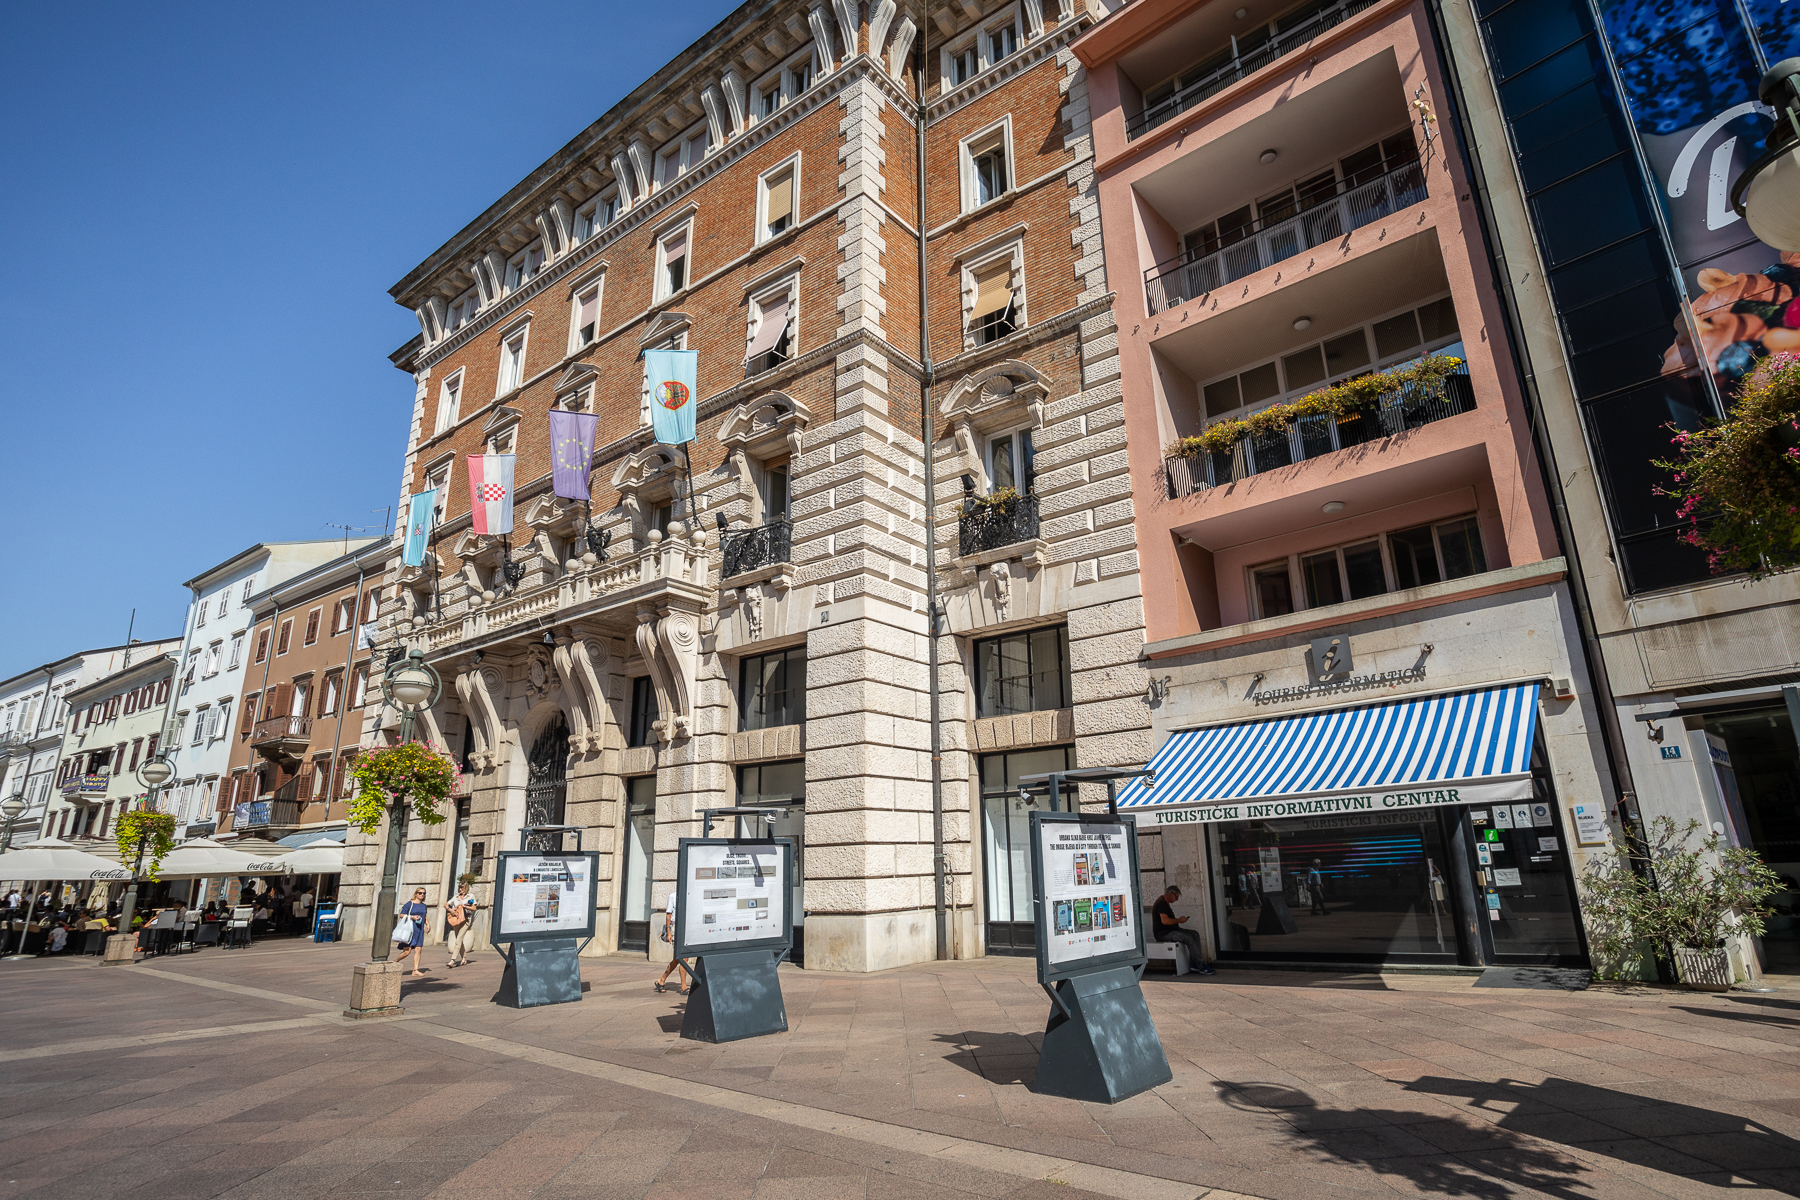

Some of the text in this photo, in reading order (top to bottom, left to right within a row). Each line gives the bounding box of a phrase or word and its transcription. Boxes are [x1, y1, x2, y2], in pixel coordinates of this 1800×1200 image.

[1254, 666, 1427, 701] TOURIST INFORMATION
[1664, 747, 1676, 755] 14
[1156, 789, 1461, 823] TURISTIČKI INFORMATIVNI CENTAR
